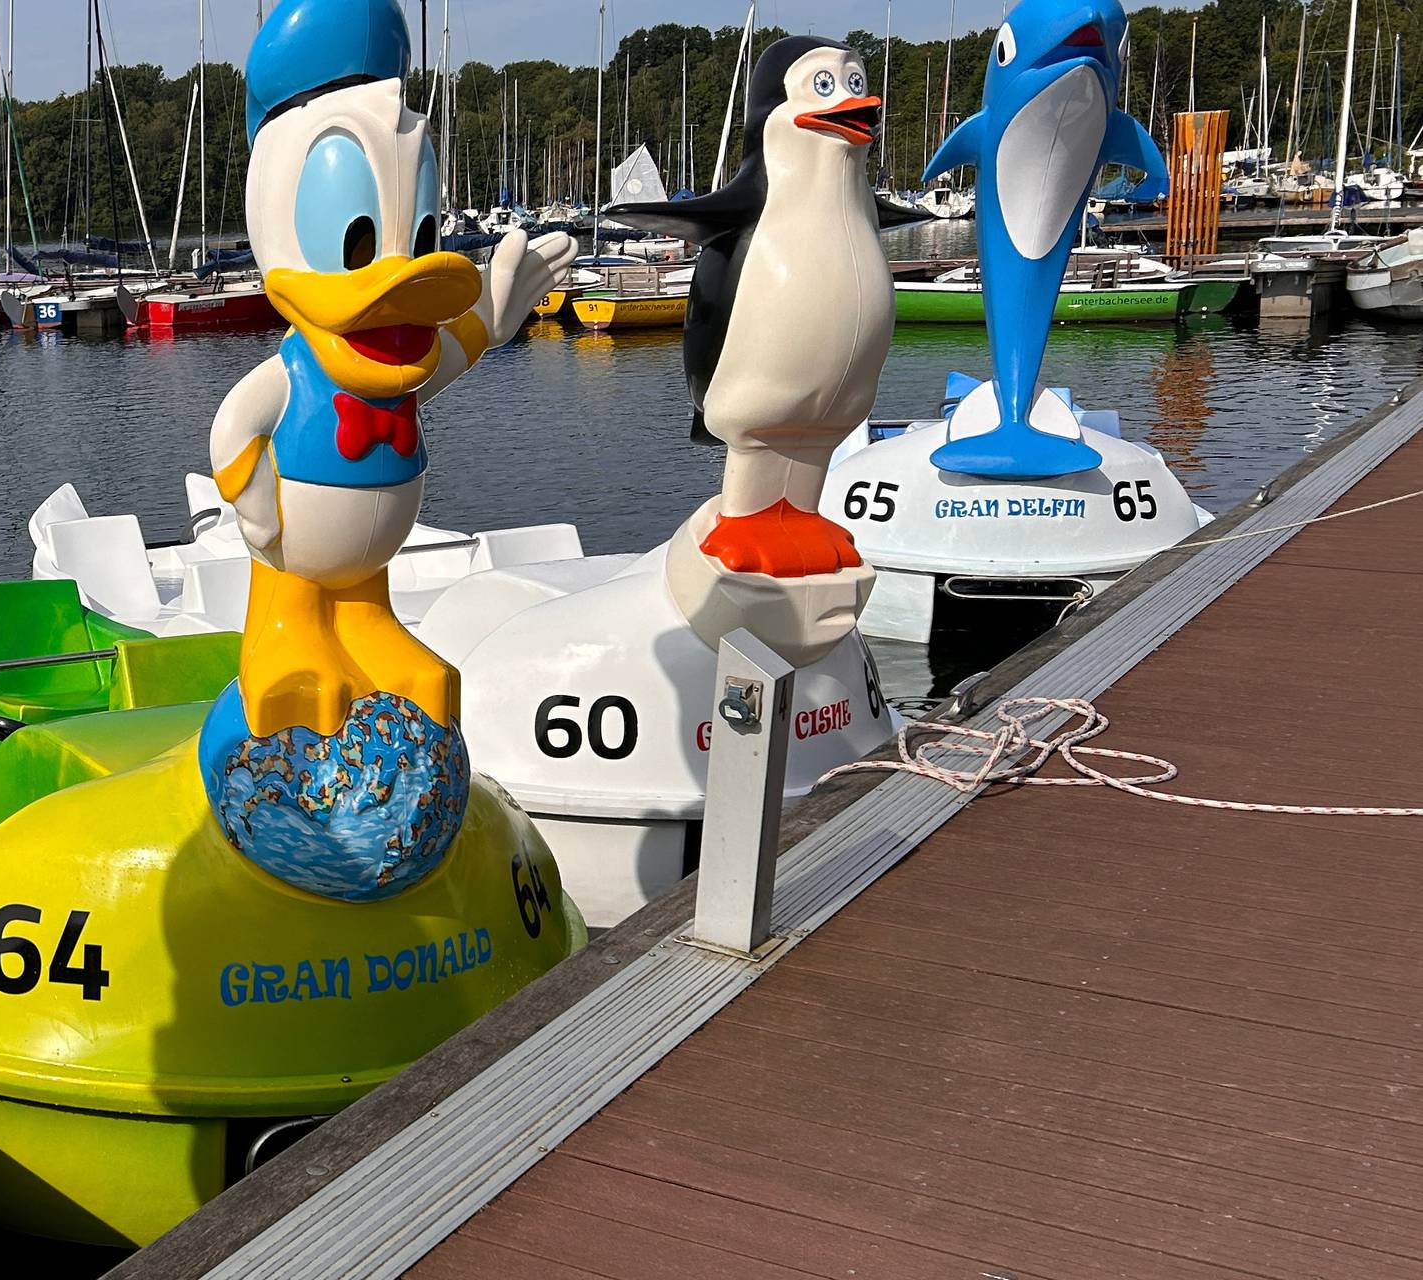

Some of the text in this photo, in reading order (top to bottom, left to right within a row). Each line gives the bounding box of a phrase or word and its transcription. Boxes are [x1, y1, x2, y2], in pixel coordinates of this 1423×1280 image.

[38, 304, 57, 318] 36
[588, 303, 599, 312] 91
[620, 302, 686, 313] unterbachersee.de
[1071, 295, 1169, 306] unterbachersee.de
[843, 480, 900, 523] 65
[935, 497, 1086, 520] GRAN DELFIN
[1112, 479, 1158, 522] 65
[534, 694, 639, 760] 60
[794, 699, 852, 741] CISNE
[511, 840, 552, 939] 64
[219, 927, 493, 1007] GRAN DONALD
